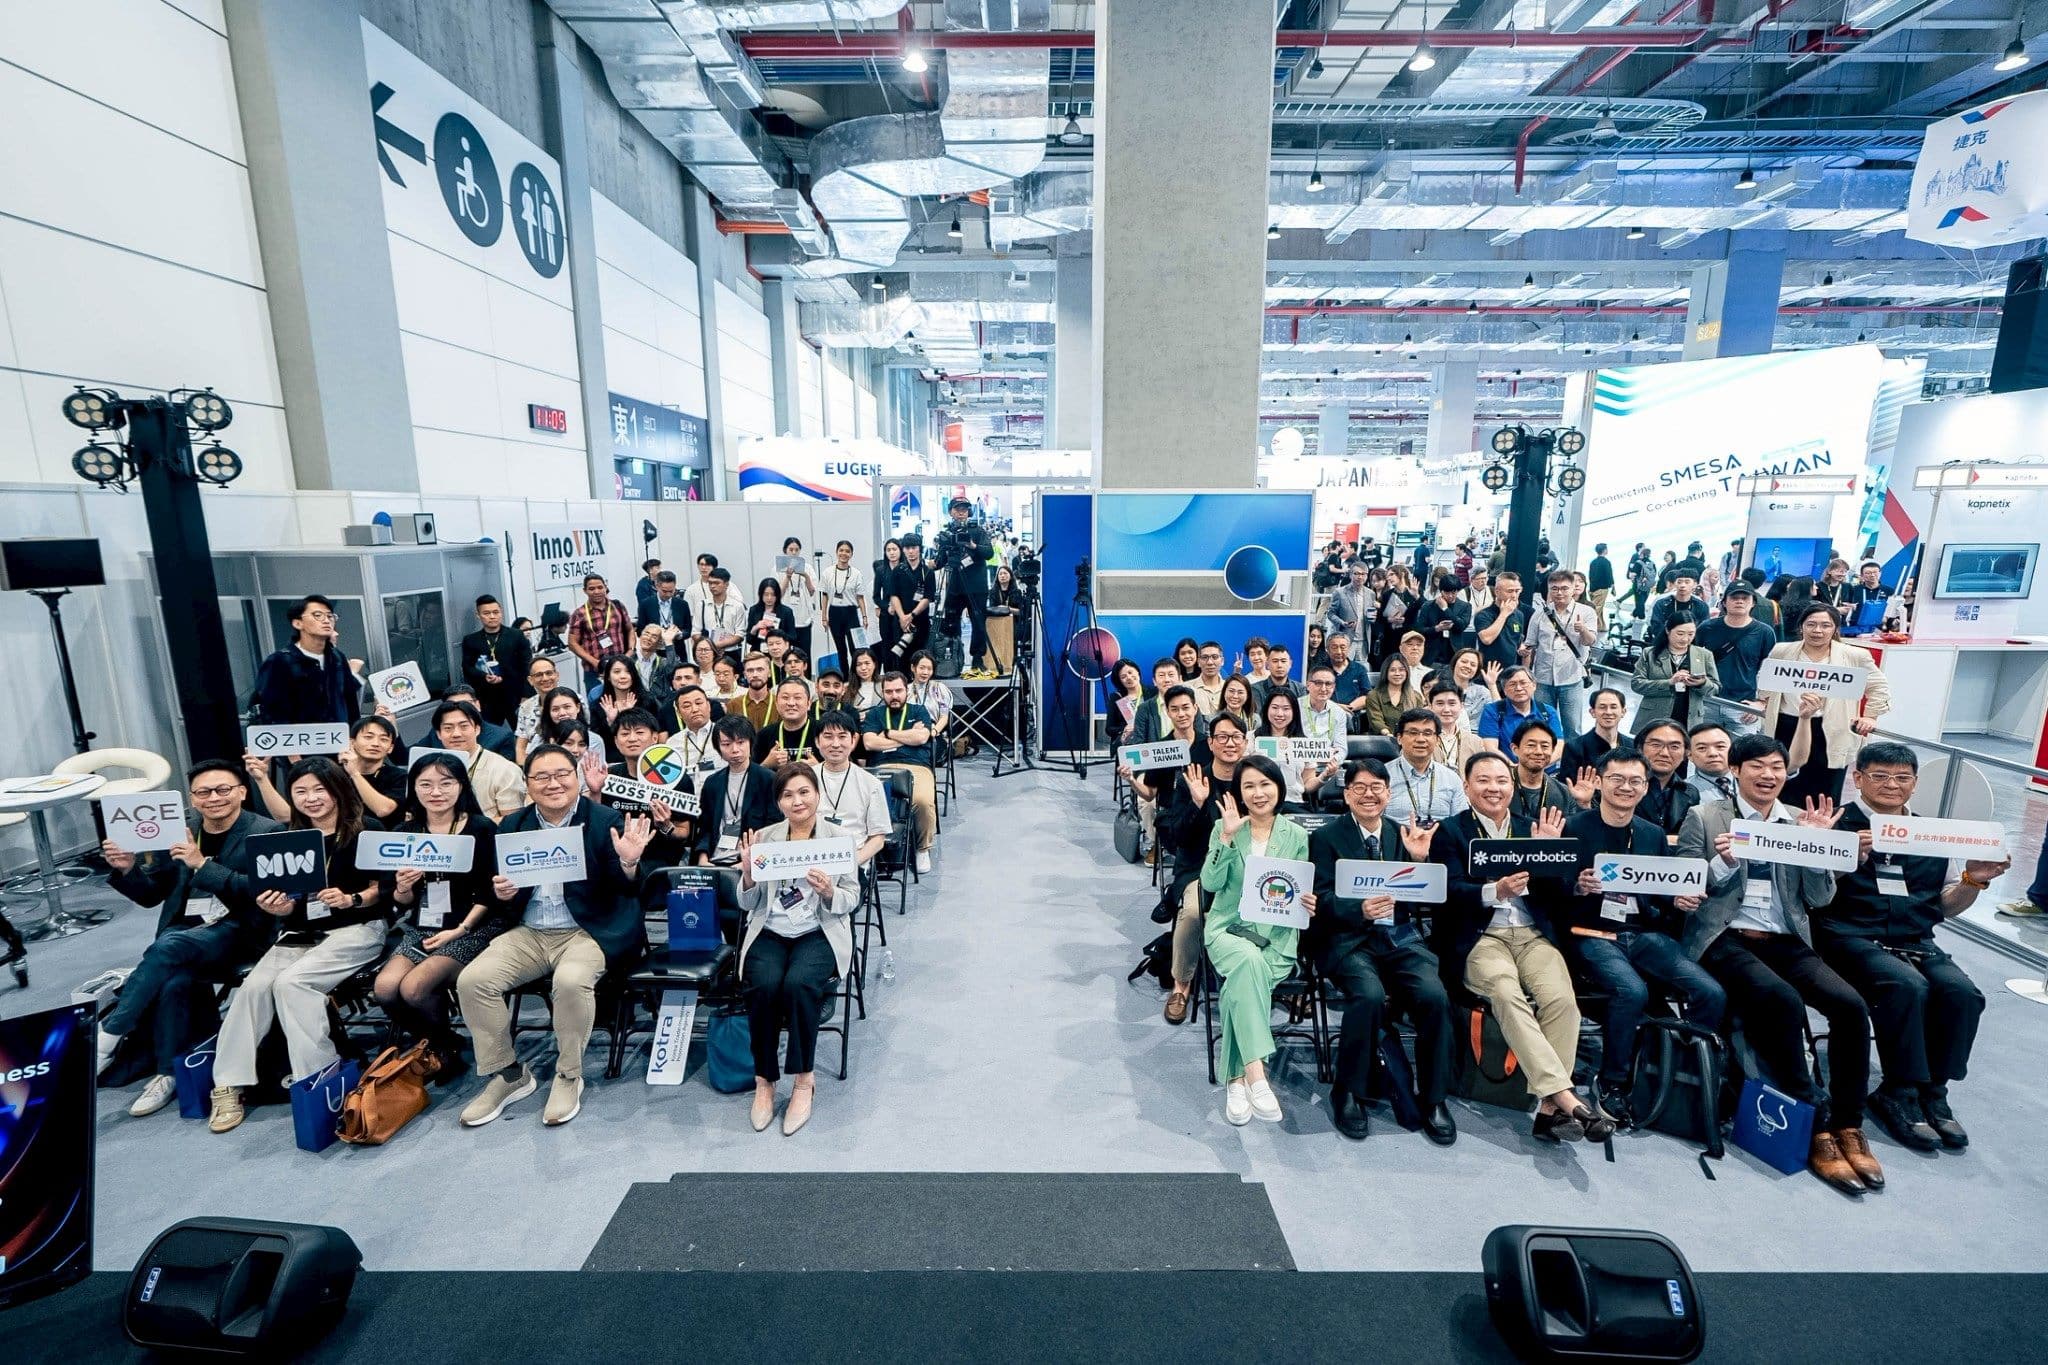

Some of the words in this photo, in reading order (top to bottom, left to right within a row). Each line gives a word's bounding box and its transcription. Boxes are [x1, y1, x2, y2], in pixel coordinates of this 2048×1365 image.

[1953, 130, 1989, 152] 捷克
[536, 409, 565, 431] 11:05
[824, 462, 882, 476] EUGENE
[1316, 467, 1373, 487] JAPAN
[1660, 454, 1742, 487] SMESA
[1646, 489, 1717, 513] Co-creating
[1718, 451, 1831, 492] TWAN
[1968, 499, 2010, 509] kapnetix
[533, 530, 605, 560] InnoVEX
[551, 564, 560, 579] Pi
[564, 561, 594, 578] STAGE
[1774, 667, 1853, 683] INNOPAD
[1793, 681, 1830, 691] TAIPEI
[282, 732, 343, 747] ZREK
[1293, 741, 1327, 749] TALENT
[1152, 747, 1180, 755] TALENT
[1153, 754, 1183, 762] TAIWAN
[1293, 751, 1330, 759] TAIWAN
[606, 782, 646, 799] XOSS
[110, 804, 180, 823] ACE
[1881, 824, 1908, 838] ito
[1755, 835, 1825, 855] Three-labs
[1830, 845, 1853, 858] Inc.
[256, 850, 316, 879] MW
[1490, 850, 1524, 865] amity
[1526, 850, 1577, 862] robotics
[1354, 876, 1384, 887] DITP
[1622, 867, 1679, 884] Synvo
[1683, 872, 1701, 884] AI
[651, 1016, 673, 1073] kotra
